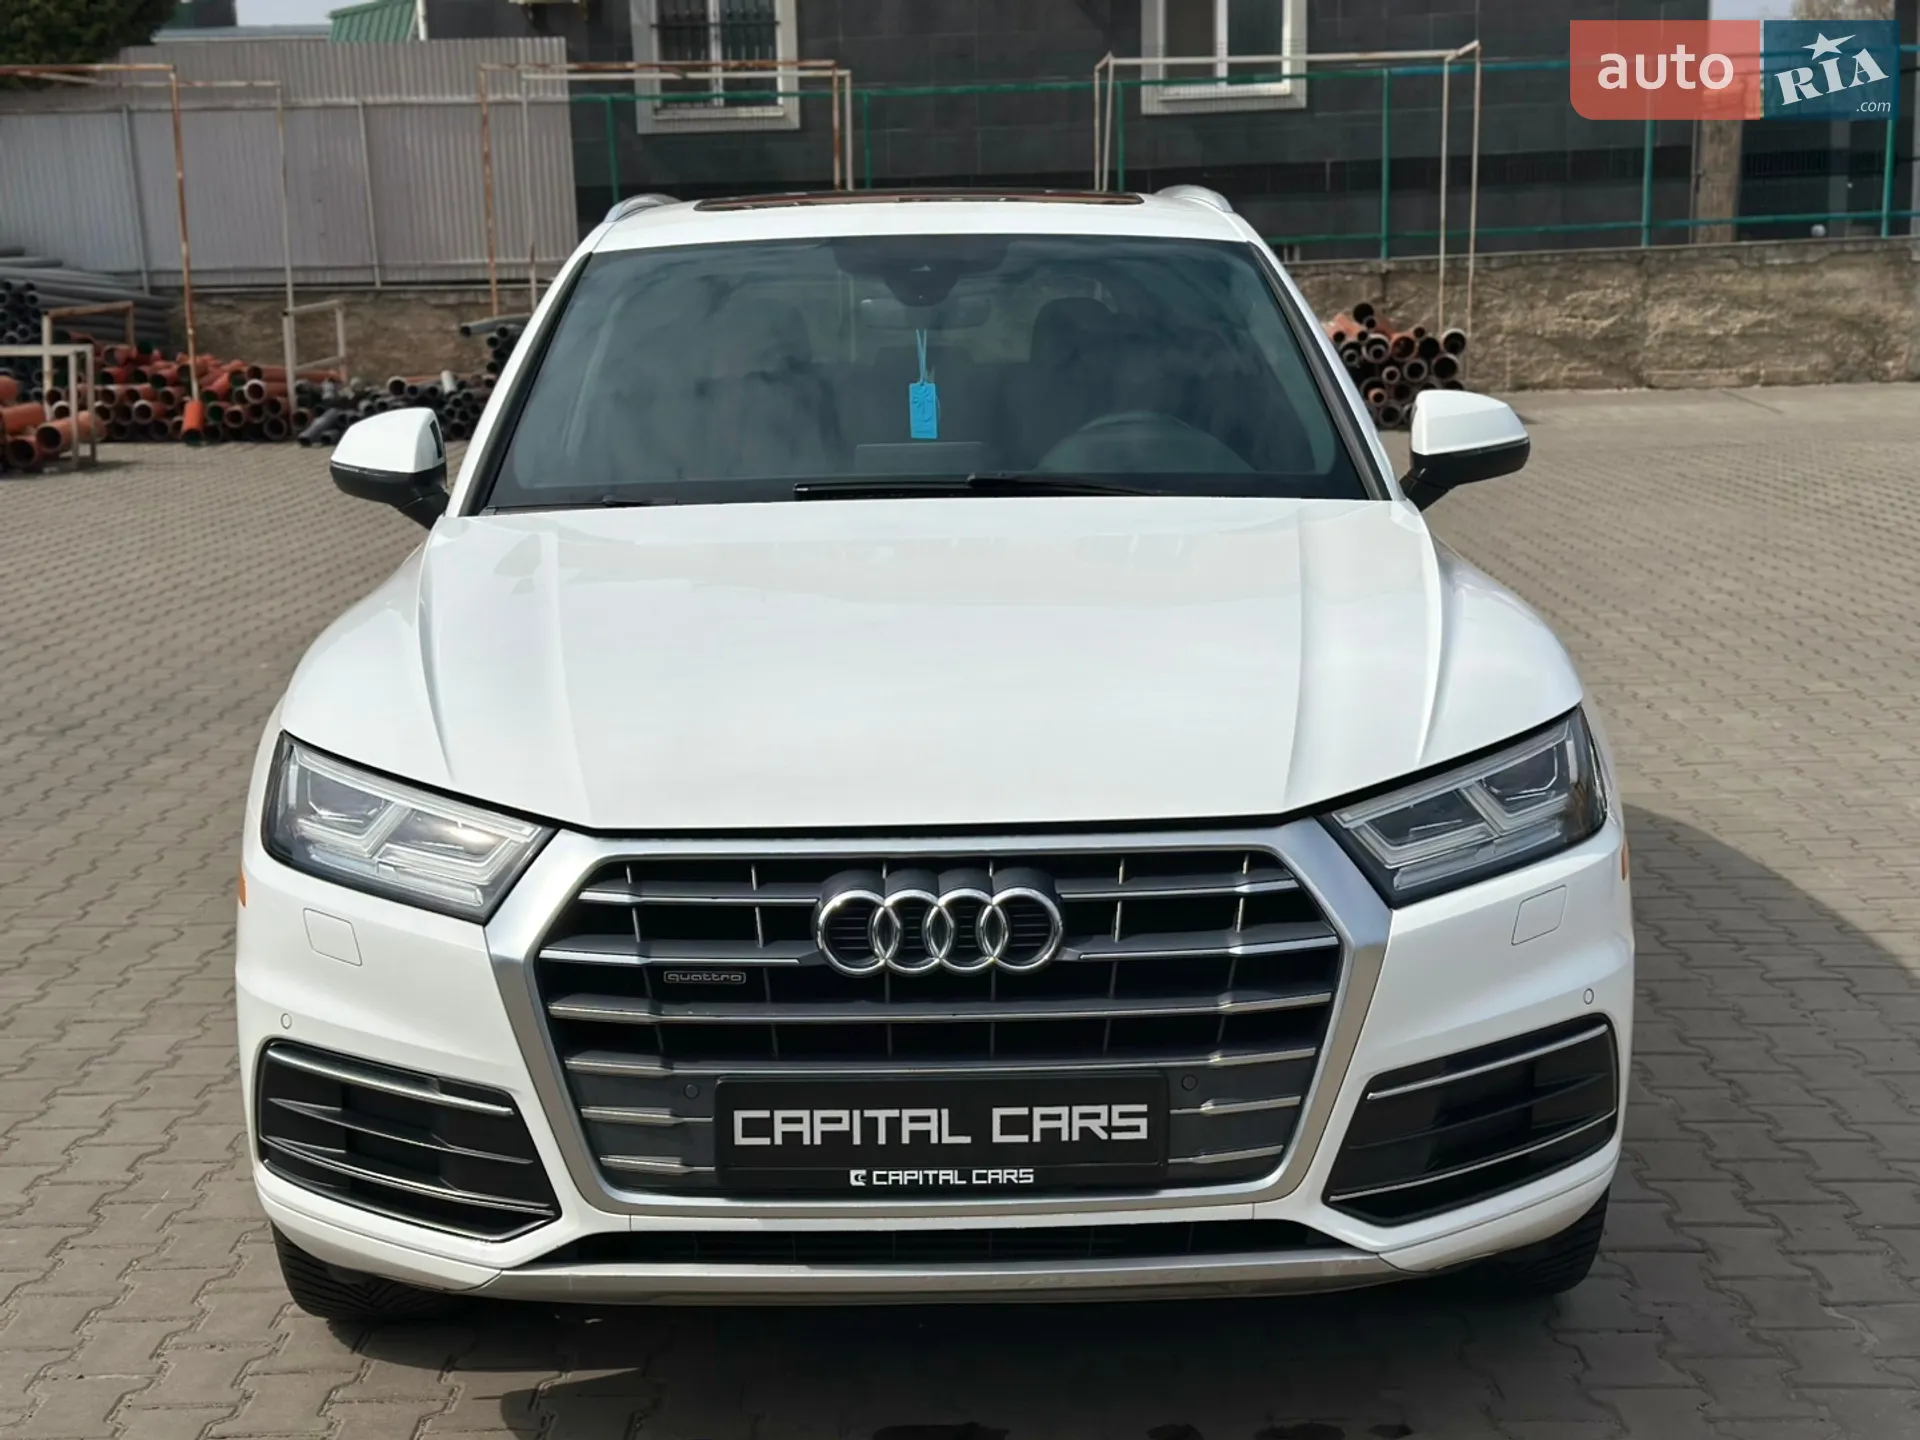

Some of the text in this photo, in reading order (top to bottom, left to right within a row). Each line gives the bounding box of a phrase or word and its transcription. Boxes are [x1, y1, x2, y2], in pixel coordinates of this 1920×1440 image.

[667, 973, 743, 983] quattro
[733, 1104, 1148, 1146] CAPITAL CARS
[872, 1168, 1034, 1186] CAPITAL CARS
